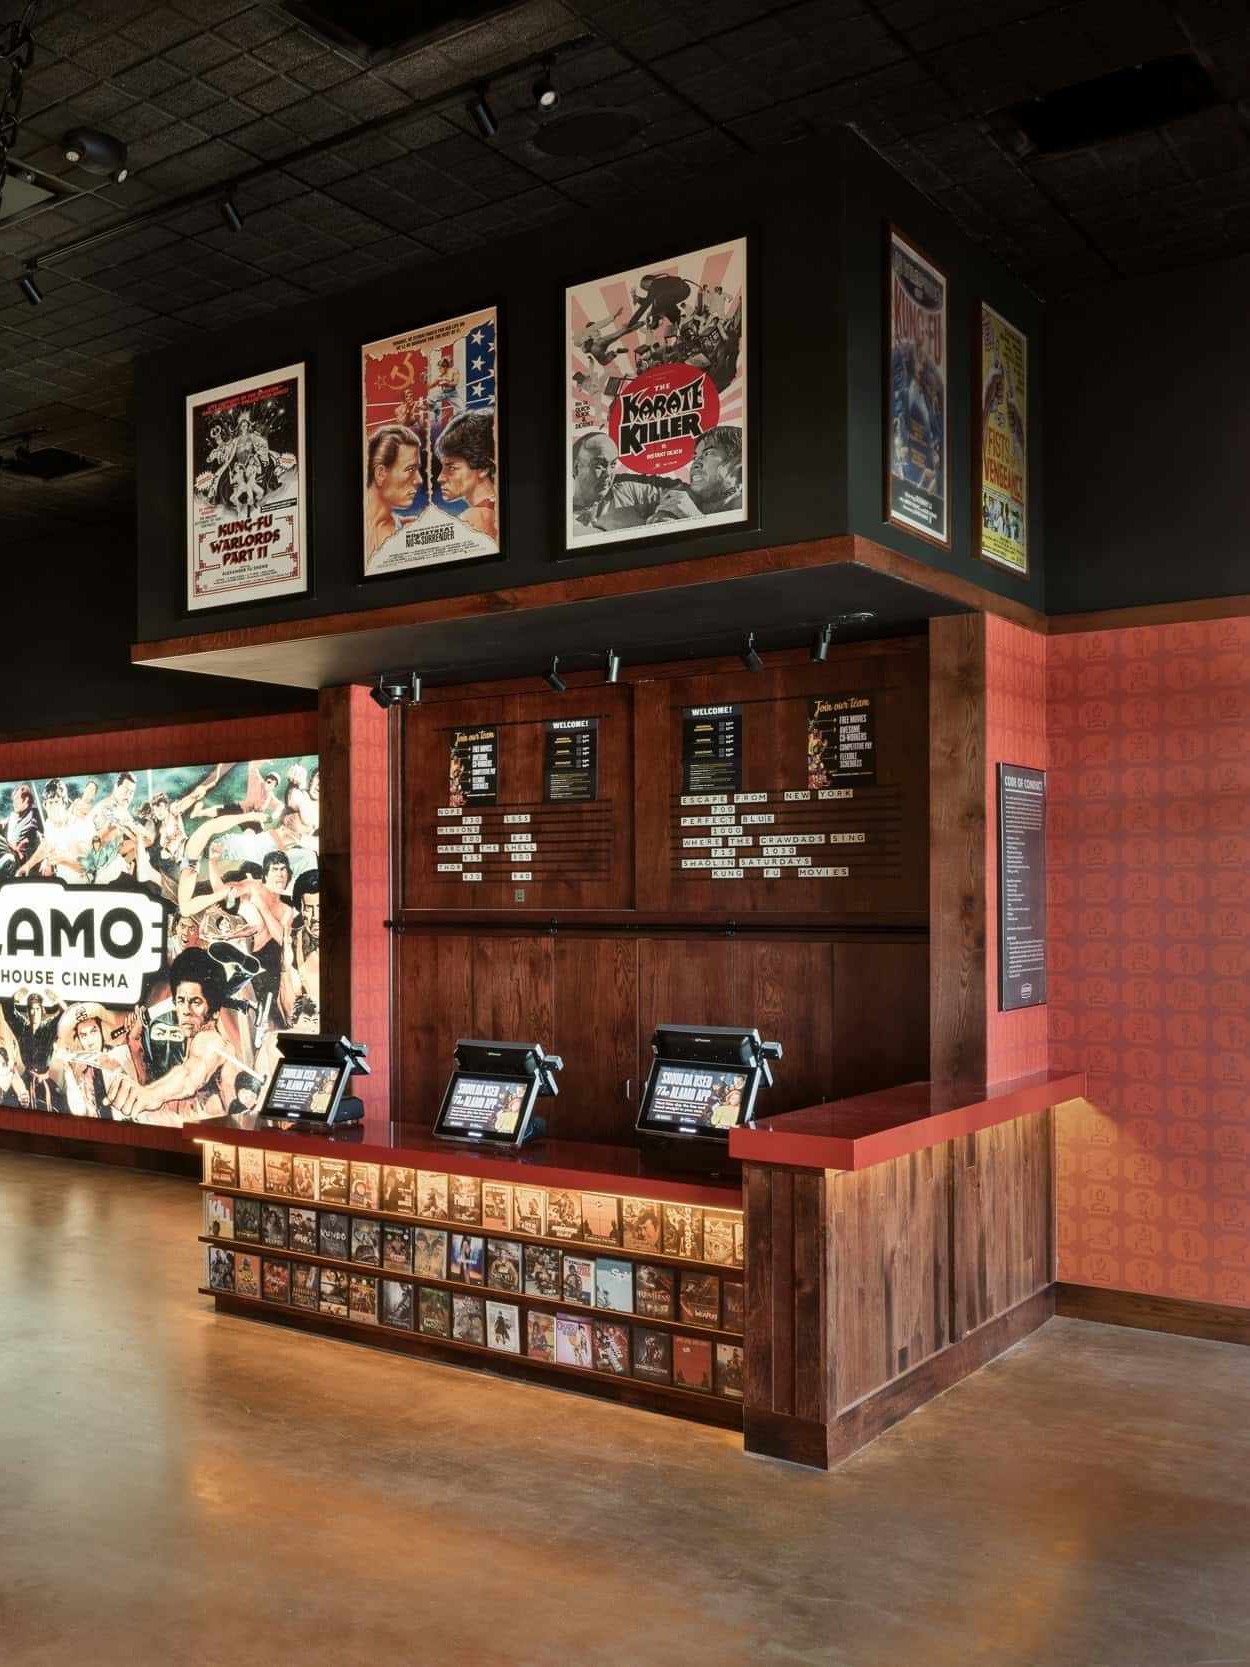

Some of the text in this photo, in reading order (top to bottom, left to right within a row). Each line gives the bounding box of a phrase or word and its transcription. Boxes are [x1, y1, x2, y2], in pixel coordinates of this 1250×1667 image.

[654, 383, 670, 392] THE
[621, 374, 705, 425] KARATE
[620, 412, 701, 455] KILLER
[989, 427, 1009, 461] FISTS
[218, 514, 273, 538] KUNG-FU
[209, 528, 281, 554] WARLORDS
[222, 545, 268, 566] PART II
[692, 706, 732, 716] WELCOME!
[814, 700, 833, 717] Join
[834, 702, 847, 710] our
[553, 720, 588, 729] WELCOME!
[839, 714, 867, 724] FREE MOVIES
[682, 790, 851, 804] ESCAPE FROM NEW YORK
[682, 815, 773, 825] PERFECT BLUE
[438, 826, 478, 834] MINIONS
[505, 843, 535, 851] SHELL
[684, 838, 720, 846] WHERE
[760, 835, 823, 844] CRAWDADS
[832, 834, 864, 842] SING
[741, 857, 810, 866] SATURDAYS
[799, 868, 847, 876] MOVIES
[61, 971, 129, 989] CINEMA
[661, 1071, 713, 1089] SHOULDA USED
[670, 1087, 696, 1101] ALAMO
[695, 1089, 712, 1102] APP
